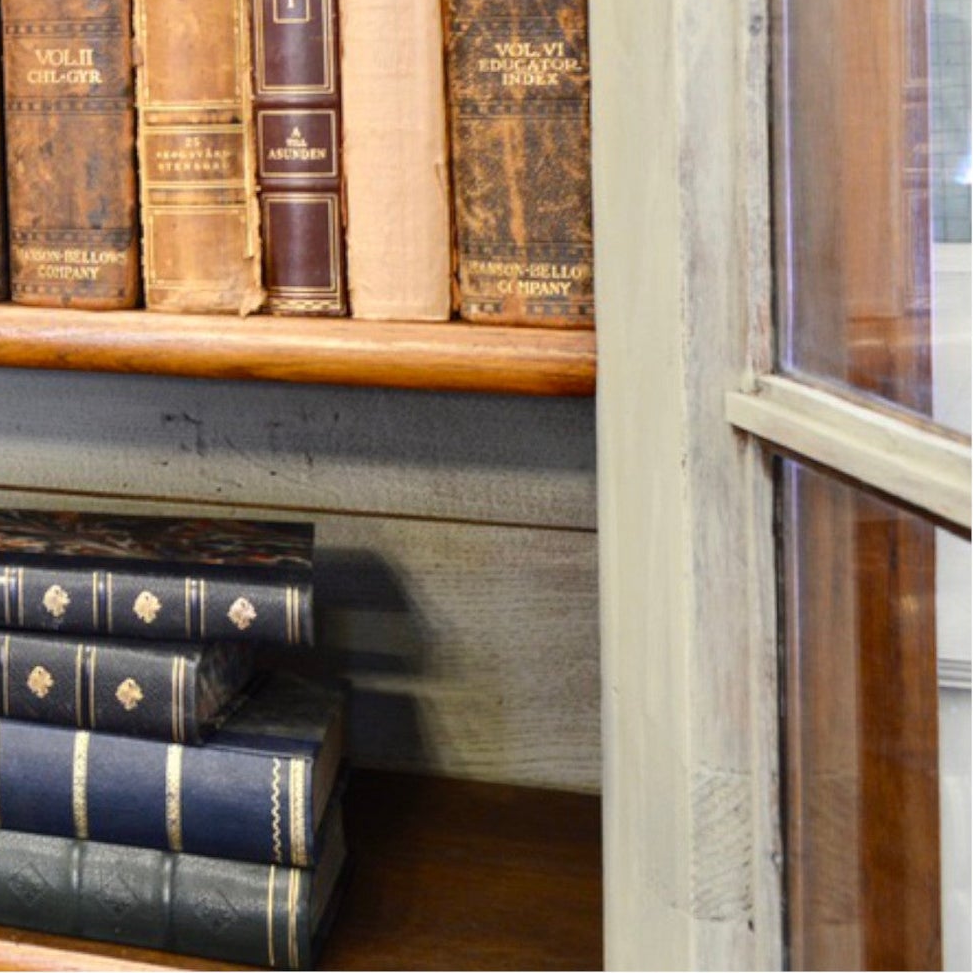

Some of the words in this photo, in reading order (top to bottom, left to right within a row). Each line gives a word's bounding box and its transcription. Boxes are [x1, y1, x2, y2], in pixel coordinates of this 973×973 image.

[543, 41, 565, 57] VI
[502, 72, 559, 87] INDEX
[39, 264, 100, 280] COMPANY
